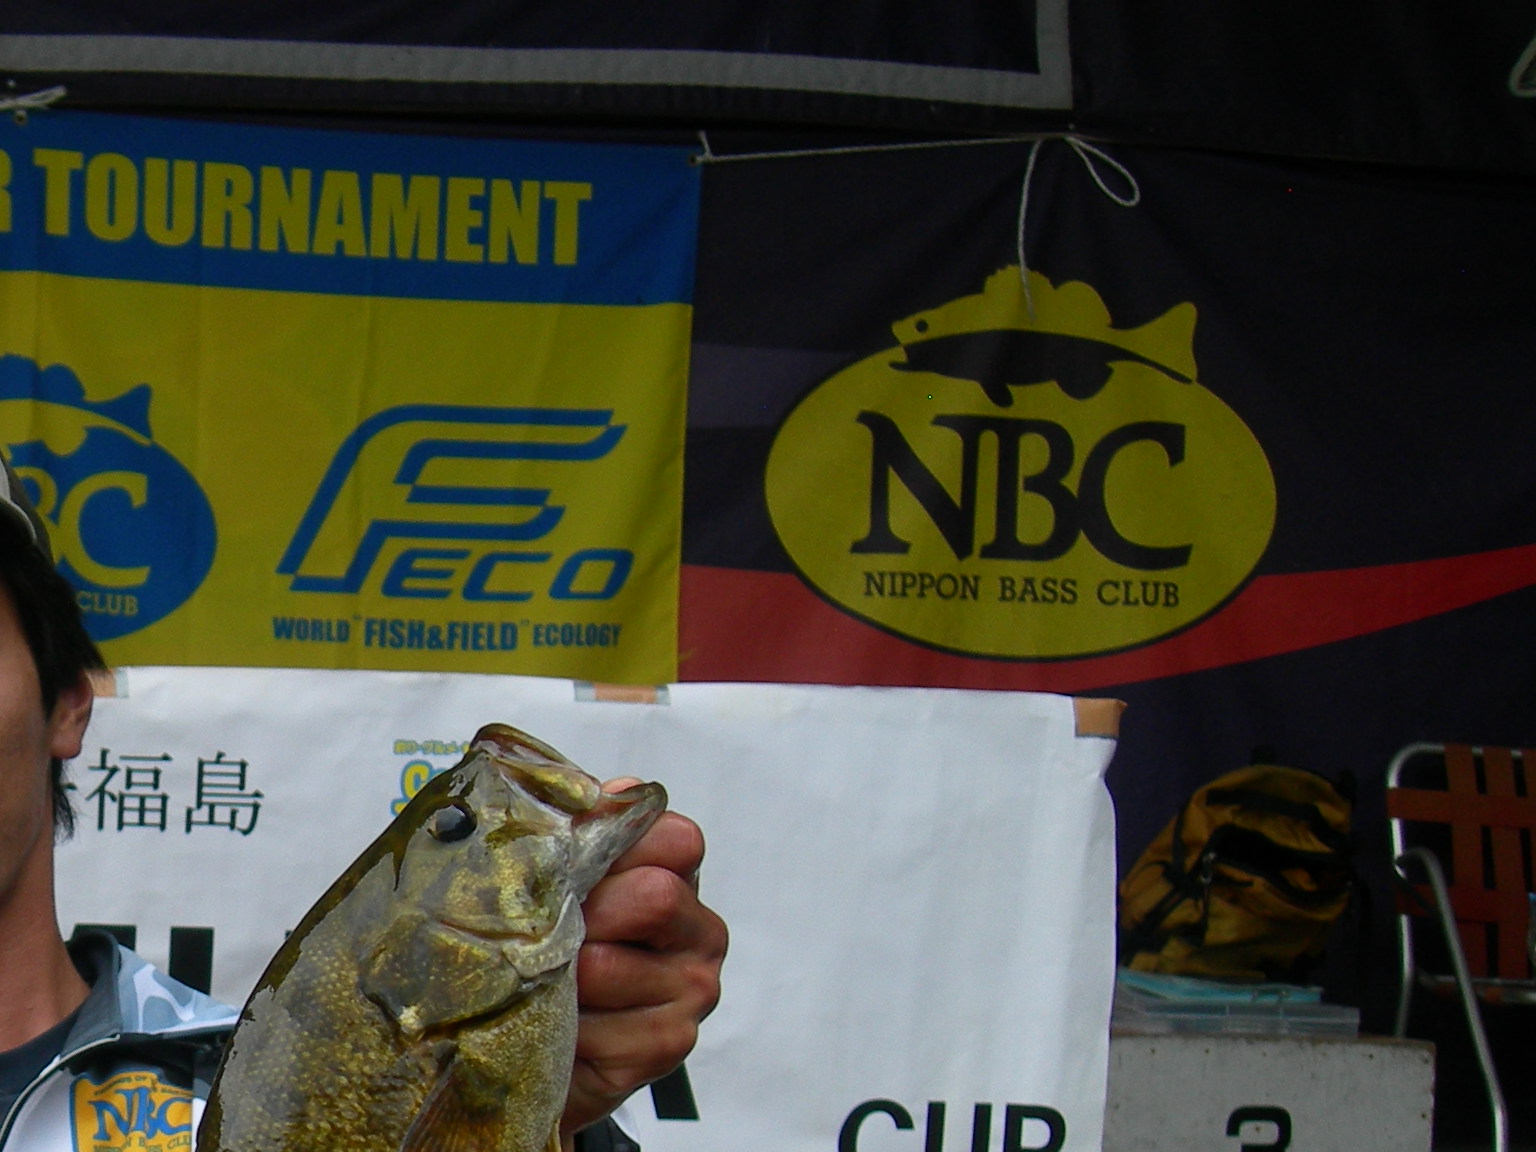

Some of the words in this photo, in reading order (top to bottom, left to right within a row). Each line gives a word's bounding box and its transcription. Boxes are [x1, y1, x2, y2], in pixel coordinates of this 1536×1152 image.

[34, 148, 593, 266] TOURNAMENT
[850, 410, 1194, 571] NBC
[272, 616, 351, 643] WORLD
[532, 623, 623, 648] ECOLOGY
[863, 571, 980, 603] NIPPON
[998, 577, 1078, 606] BASS
[1096, 580, 1180, 609] CLUB
[63, 747, 265, 838] 福島
